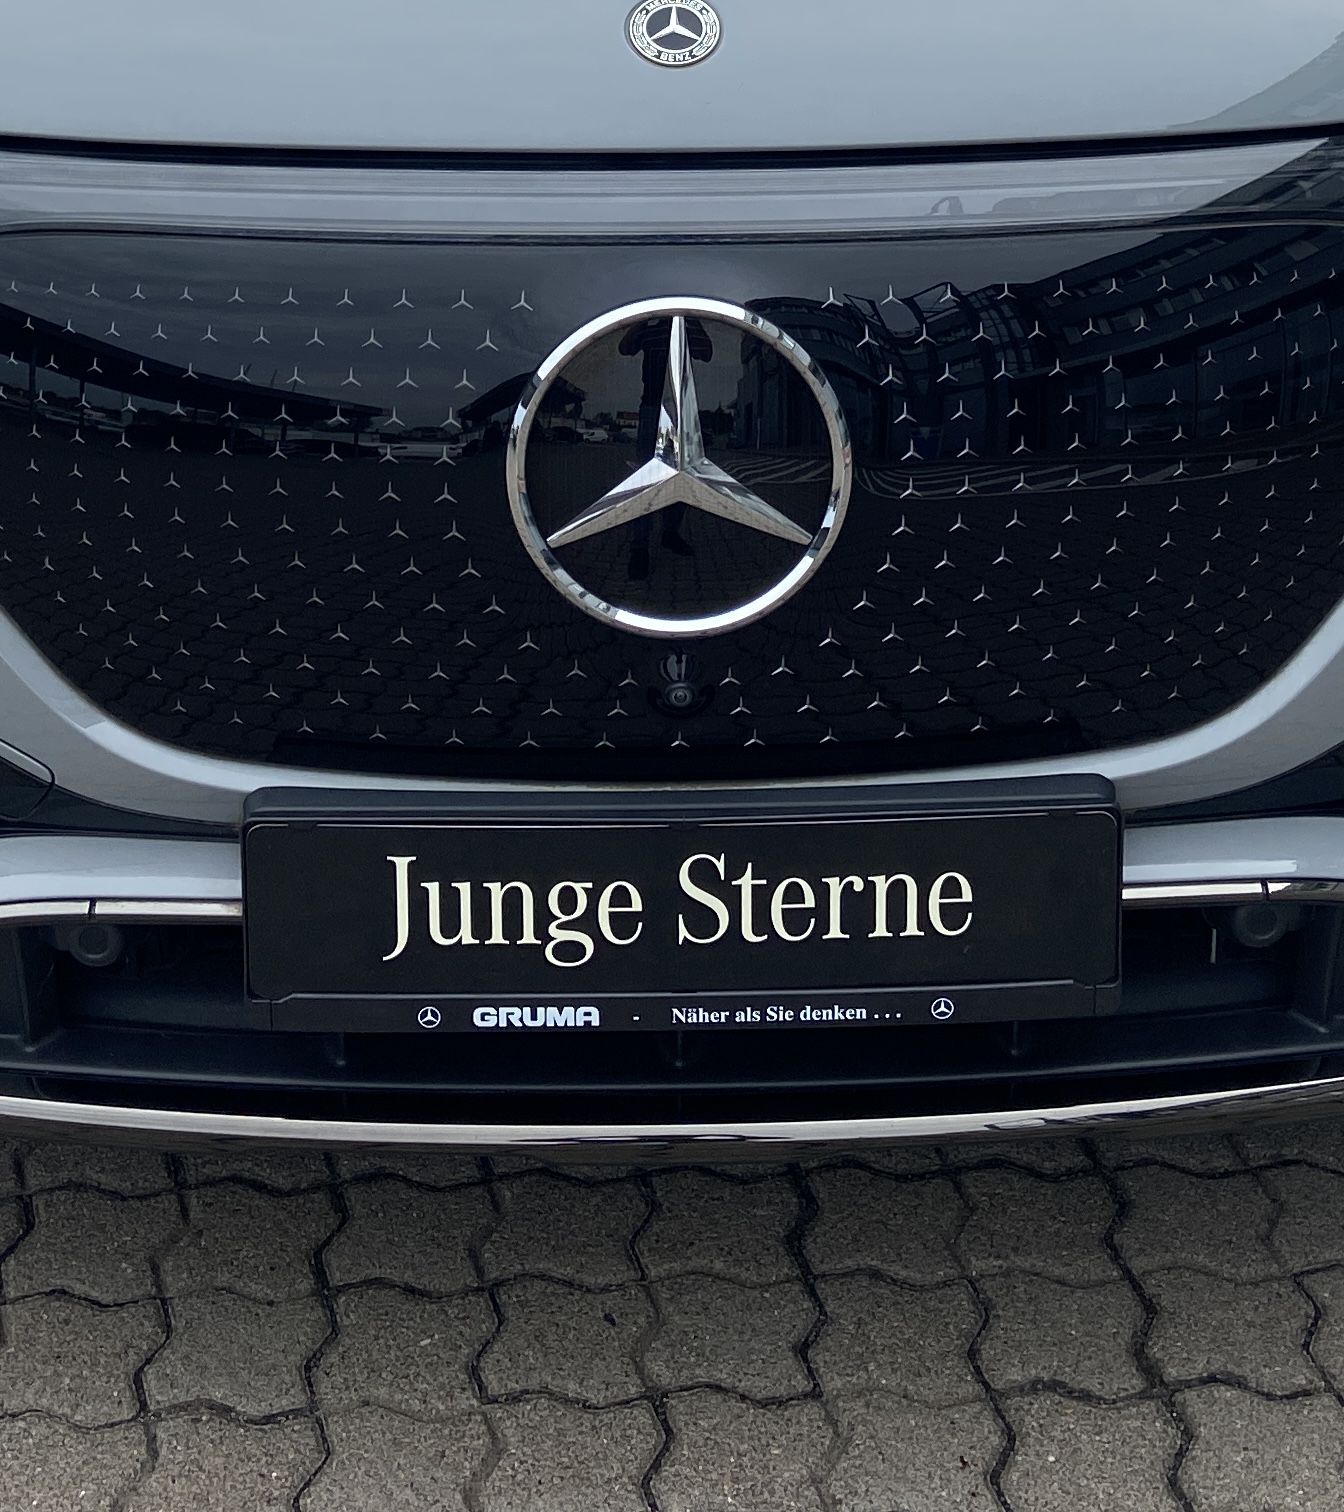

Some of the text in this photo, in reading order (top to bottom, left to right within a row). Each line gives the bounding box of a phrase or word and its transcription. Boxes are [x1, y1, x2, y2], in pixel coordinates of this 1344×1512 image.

[659, 52, 692, 62] BENZ
[382, 852, 975, 969] Junge Sterne
[472, 1006, 600, 1028] GRUMA
[671, 1006, 729, 1025] Näher
[734, 1005, 760, 1023] als
[765, 1004, 794, 1022] Sie
[799, 1003, 868, 1022] denken
